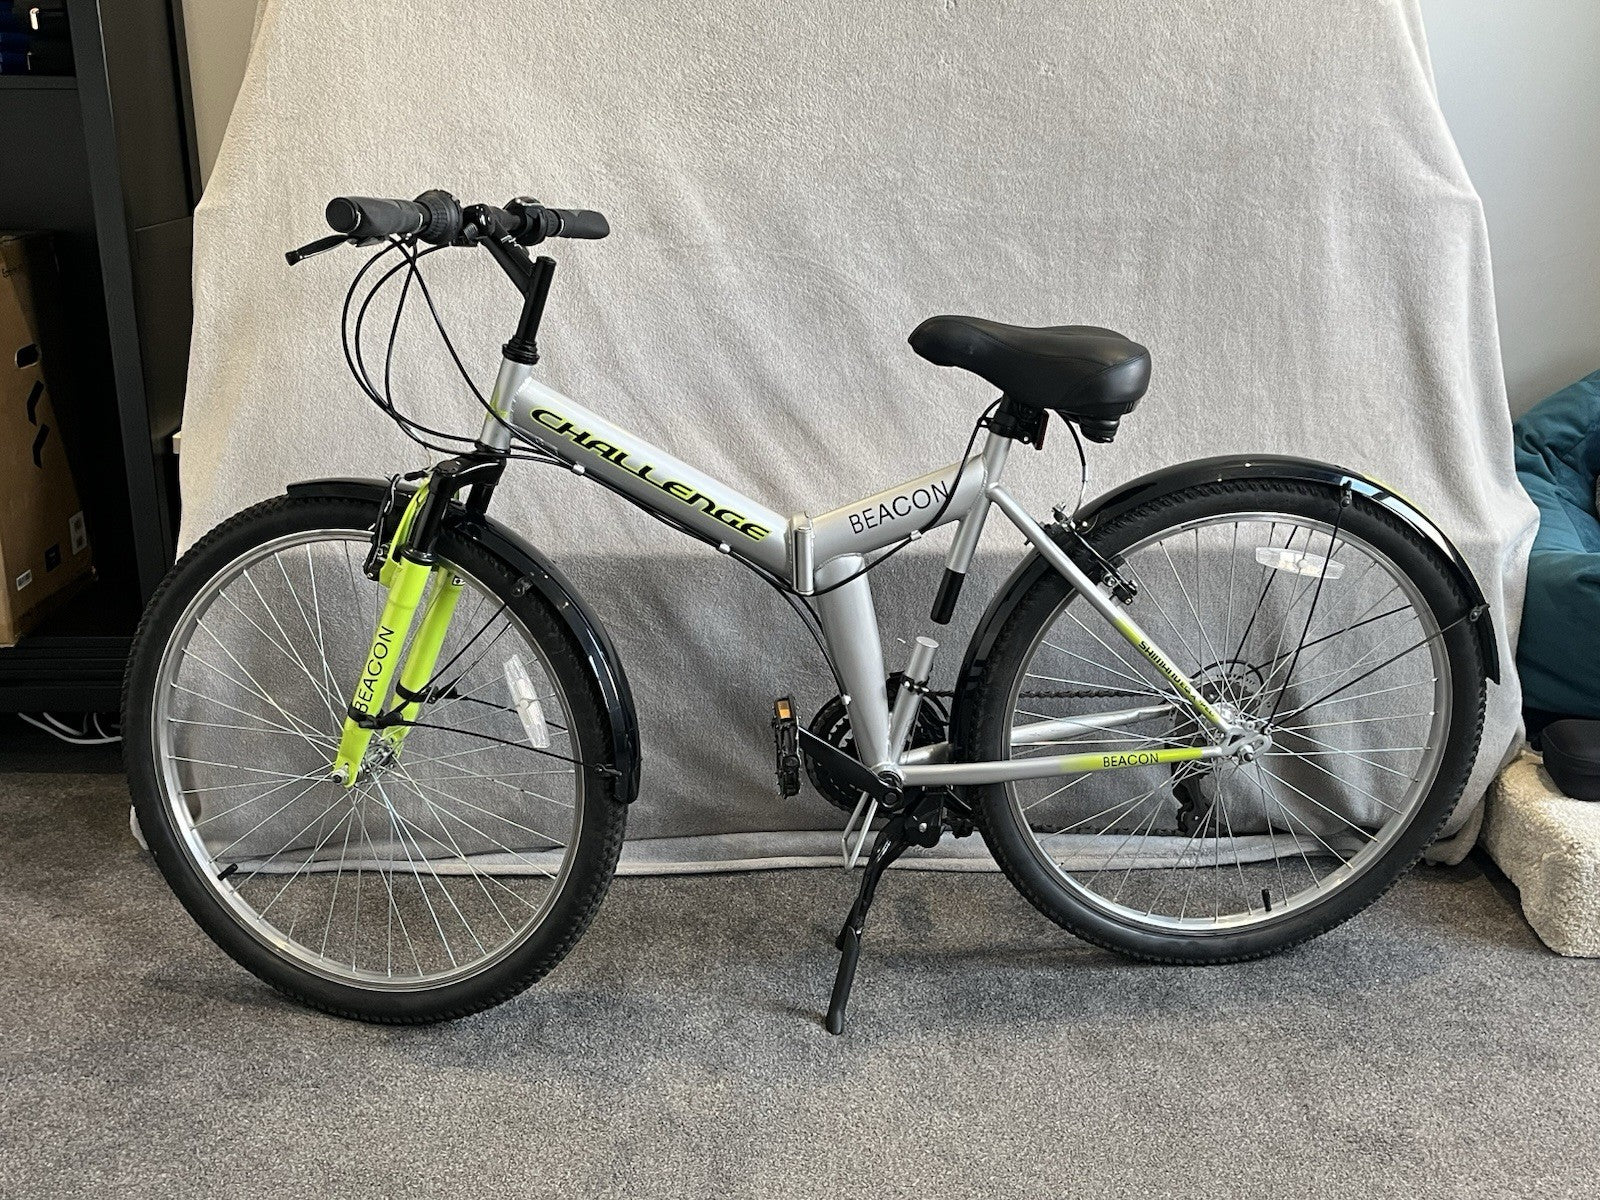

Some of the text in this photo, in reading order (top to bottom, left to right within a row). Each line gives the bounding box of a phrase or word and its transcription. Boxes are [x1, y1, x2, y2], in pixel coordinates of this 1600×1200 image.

[531, 408, 770, 541] CHALLENGE
[848, 481, 948, 534] BEACON
[354, 626, 395, 713] BEACON
[1103, 753, 1159, 768] BEACON
